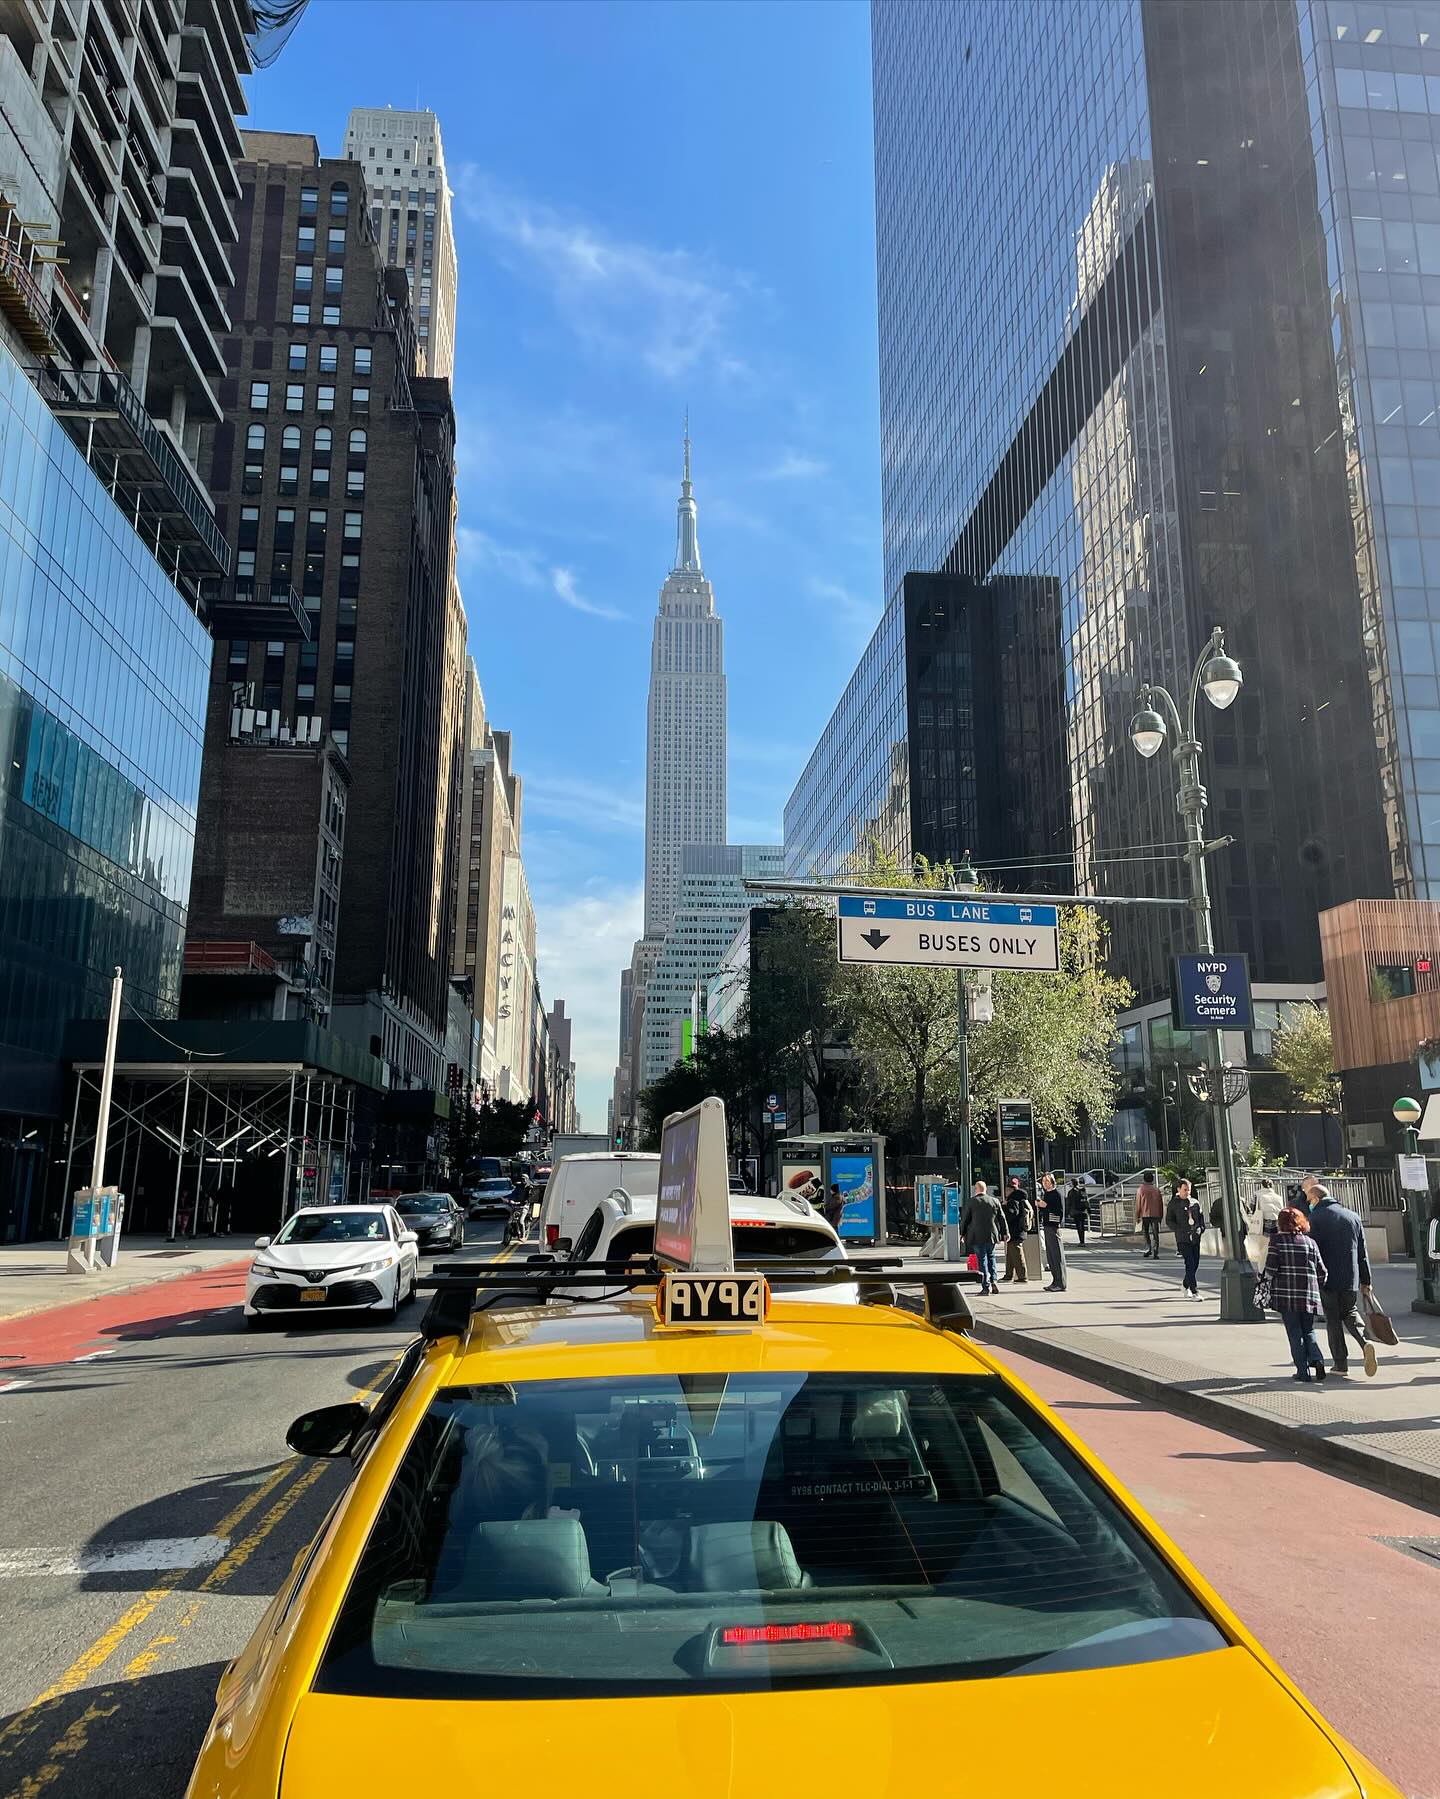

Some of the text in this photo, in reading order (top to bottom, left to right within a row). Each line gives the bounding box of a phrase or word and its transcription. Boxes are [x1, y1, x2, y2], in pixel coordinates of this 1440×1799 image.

[906, 903, 990, 921] BUS LANE
[919, 933, 1037, 955] BUSES ONLY
[498, 904, 515, 1019] MACY'S
[1197, 962, 1227, 973] NYPD
[1194, 994, 1236, 1006] Security
[1196, 1005, 1236, 1015] Camera
[671, 1281, 759, 1316] 9Y96
[814, 1483, 853, 1495] CONTACT
